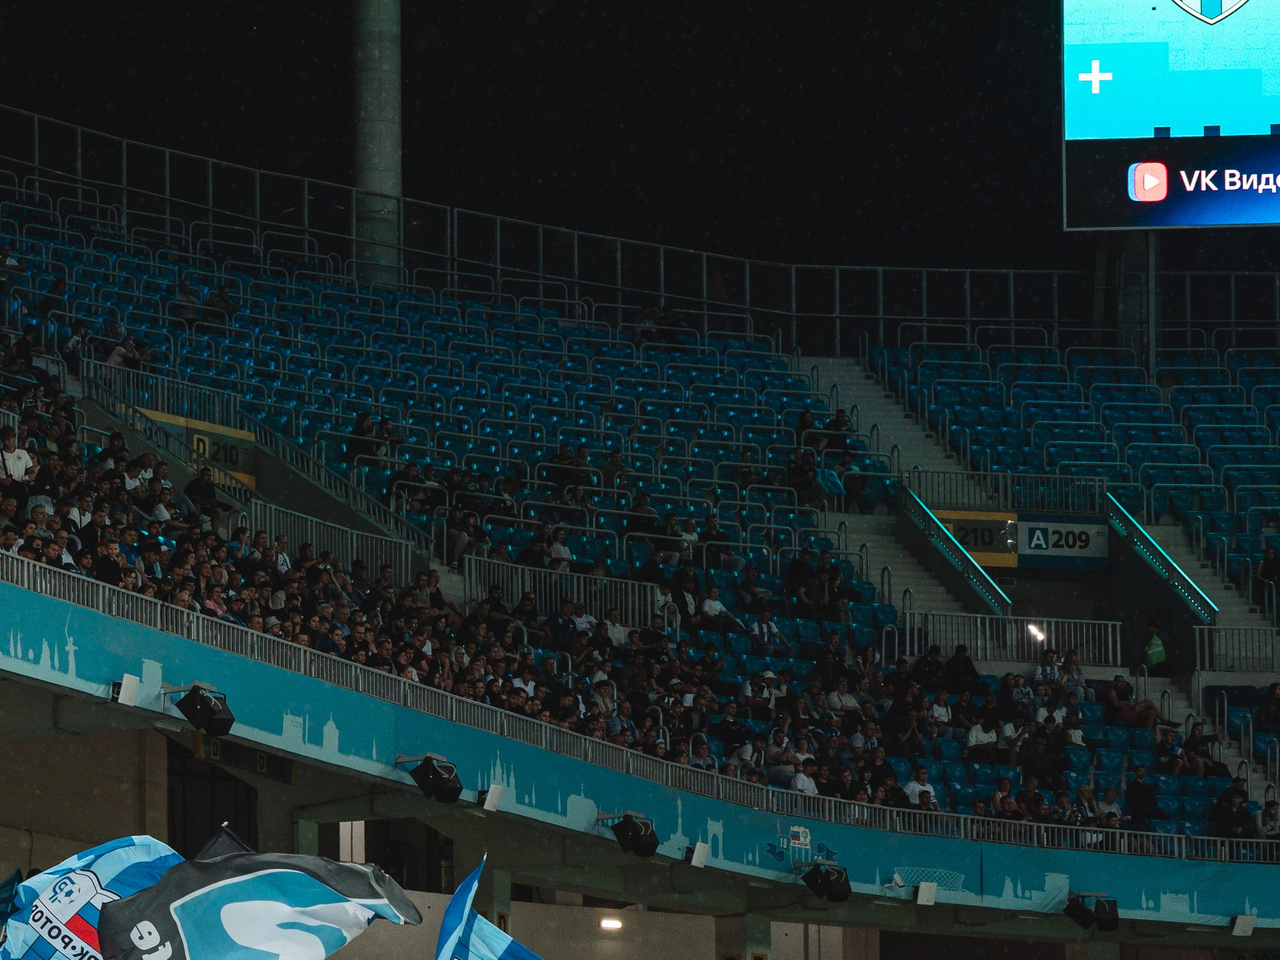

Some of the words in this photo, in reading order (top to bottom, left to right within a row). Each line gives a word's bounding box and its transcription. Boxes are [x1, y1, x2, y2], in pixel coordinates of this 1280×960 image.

[1180, 170, 1218, 192] VK
[957, 526, 994, 547] 210
[1030, 530, 1047, 548] A
[1051, 530, 1090, 549] 209
